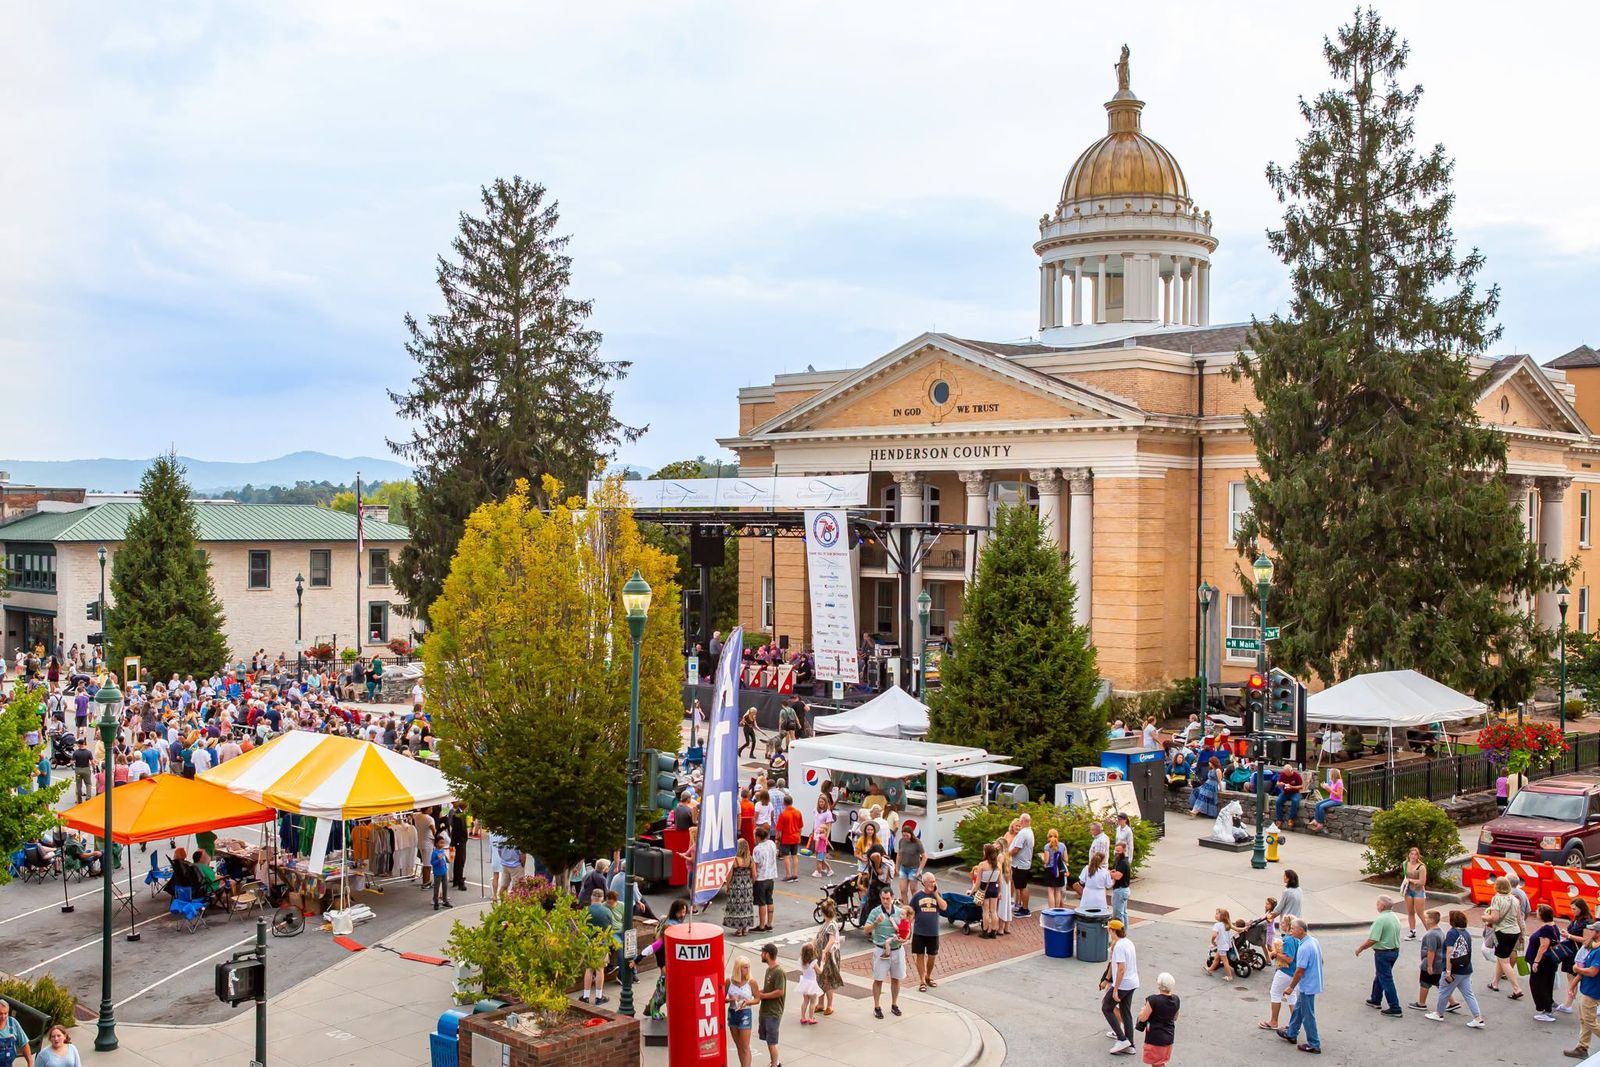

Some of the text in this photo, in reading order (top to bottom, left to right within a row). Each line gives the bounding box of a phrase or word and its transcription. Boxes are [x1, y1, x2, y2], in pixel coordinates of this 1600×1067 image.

[893, 403, 999, 417] IN GOD WE TRUST
[870, 445, 1011, 461] HENDERSON COUNTY
[1240, 640, 1255, 648] Main
[702, 652, 735, 854] ATM
[1095, 773, 1105, 782] ICE
[678, 945, 709, 959] ATM
[699, 977, 719, 1037] ATM
